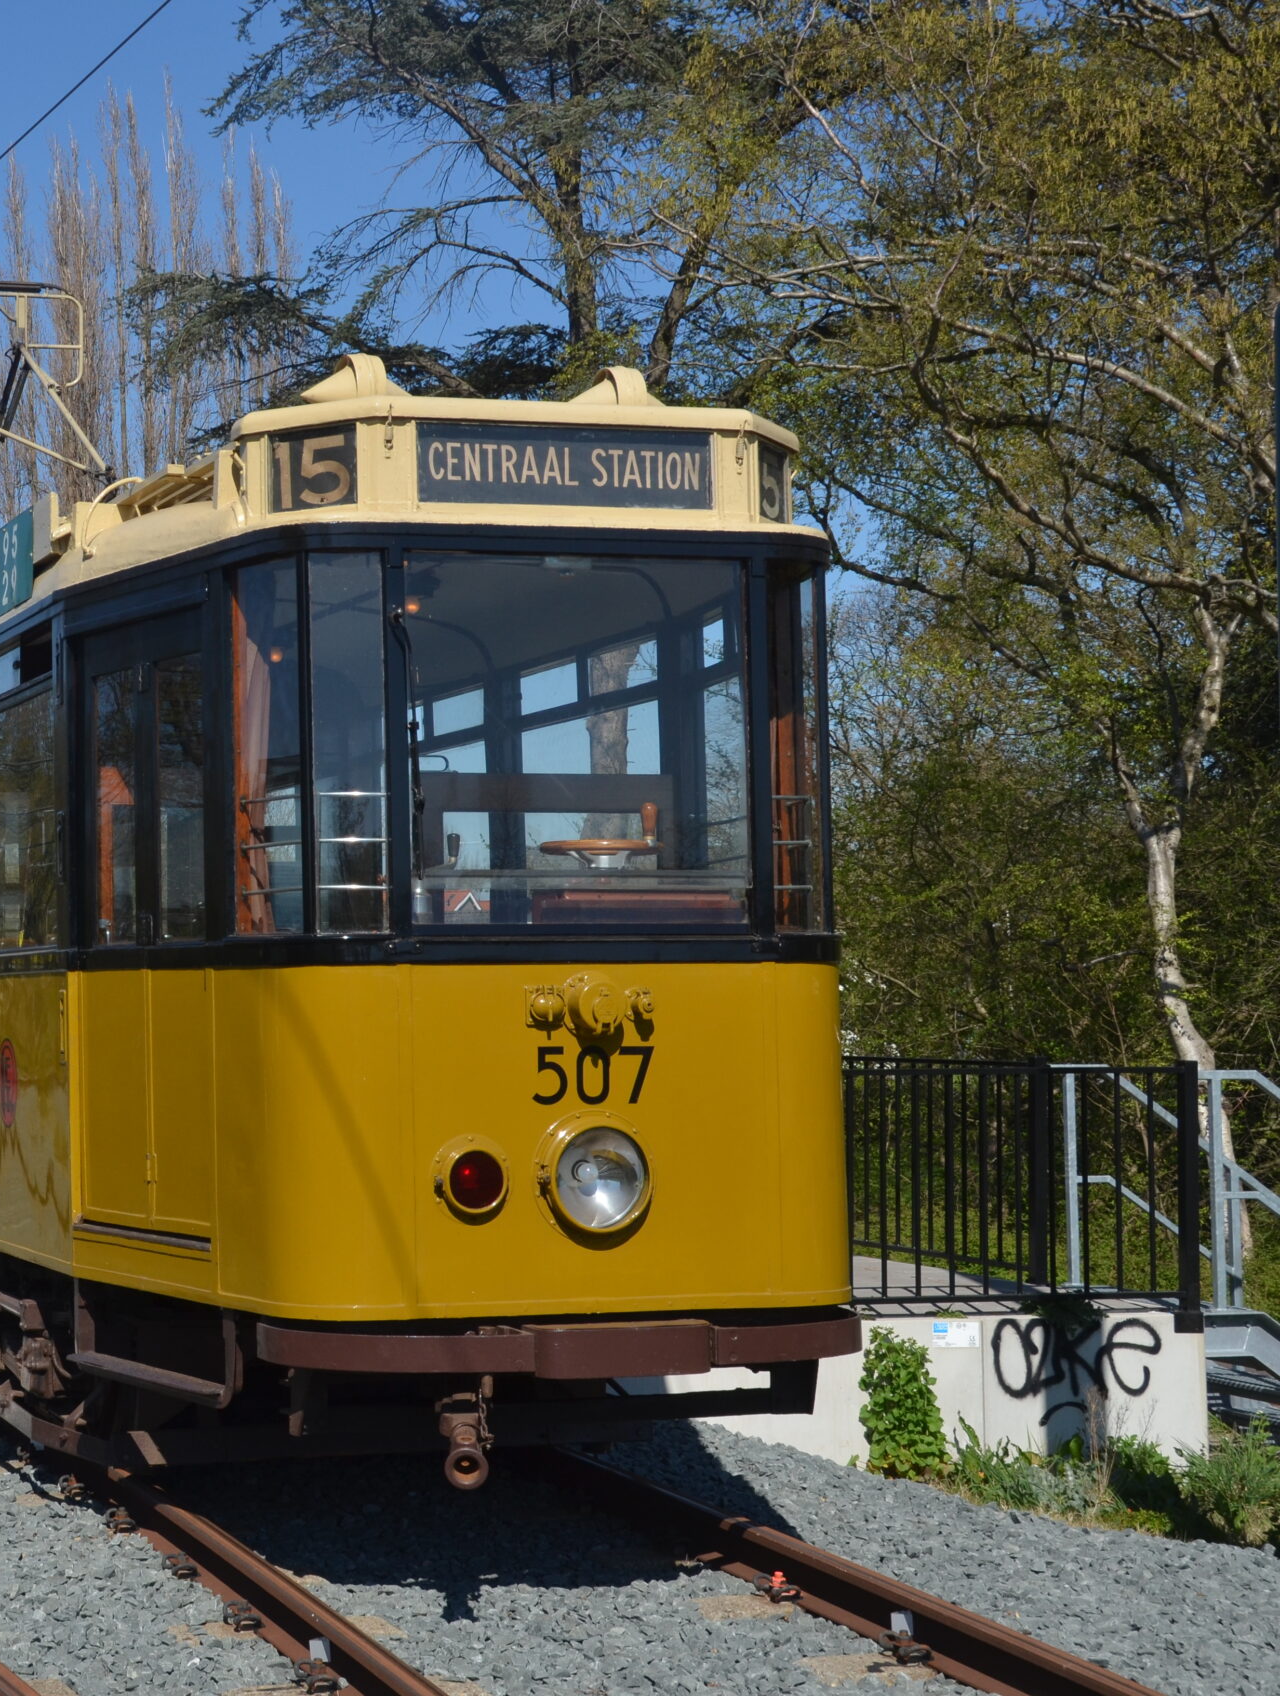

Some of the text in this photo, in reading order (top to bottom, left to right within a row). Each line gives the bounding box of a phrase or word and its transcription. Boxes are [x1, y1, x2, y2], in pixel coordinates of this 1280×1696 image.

[274, 434, 350, 510] 15
[427, 440, 701, 492] CENTRAAL STATION
[531, 1045, 656, 1106] 507
